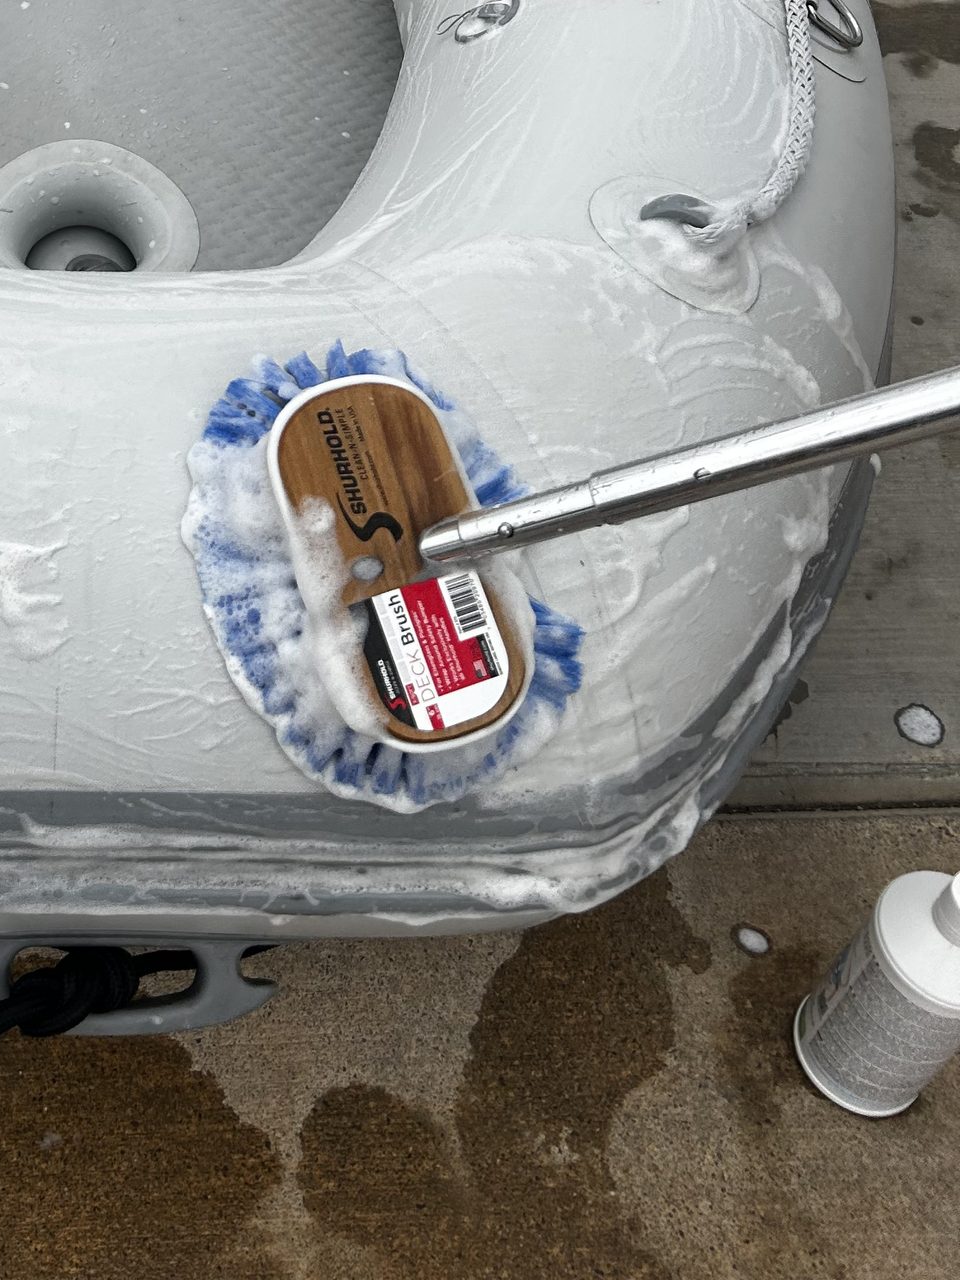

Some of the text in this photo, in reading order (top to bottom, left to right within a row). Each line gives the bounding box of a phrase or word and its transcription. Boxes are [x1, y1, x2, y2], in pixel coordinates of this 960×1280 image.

[346, 405, 356, 419] USA
[355, 425, 365, 442] Made
[317, 409, 368, 515] SHURHOLD
[388, 594, 415, 646] Brush
[376, 659, 396, 699] SHURHOLD
[406, 649, 436, 702] DECK
